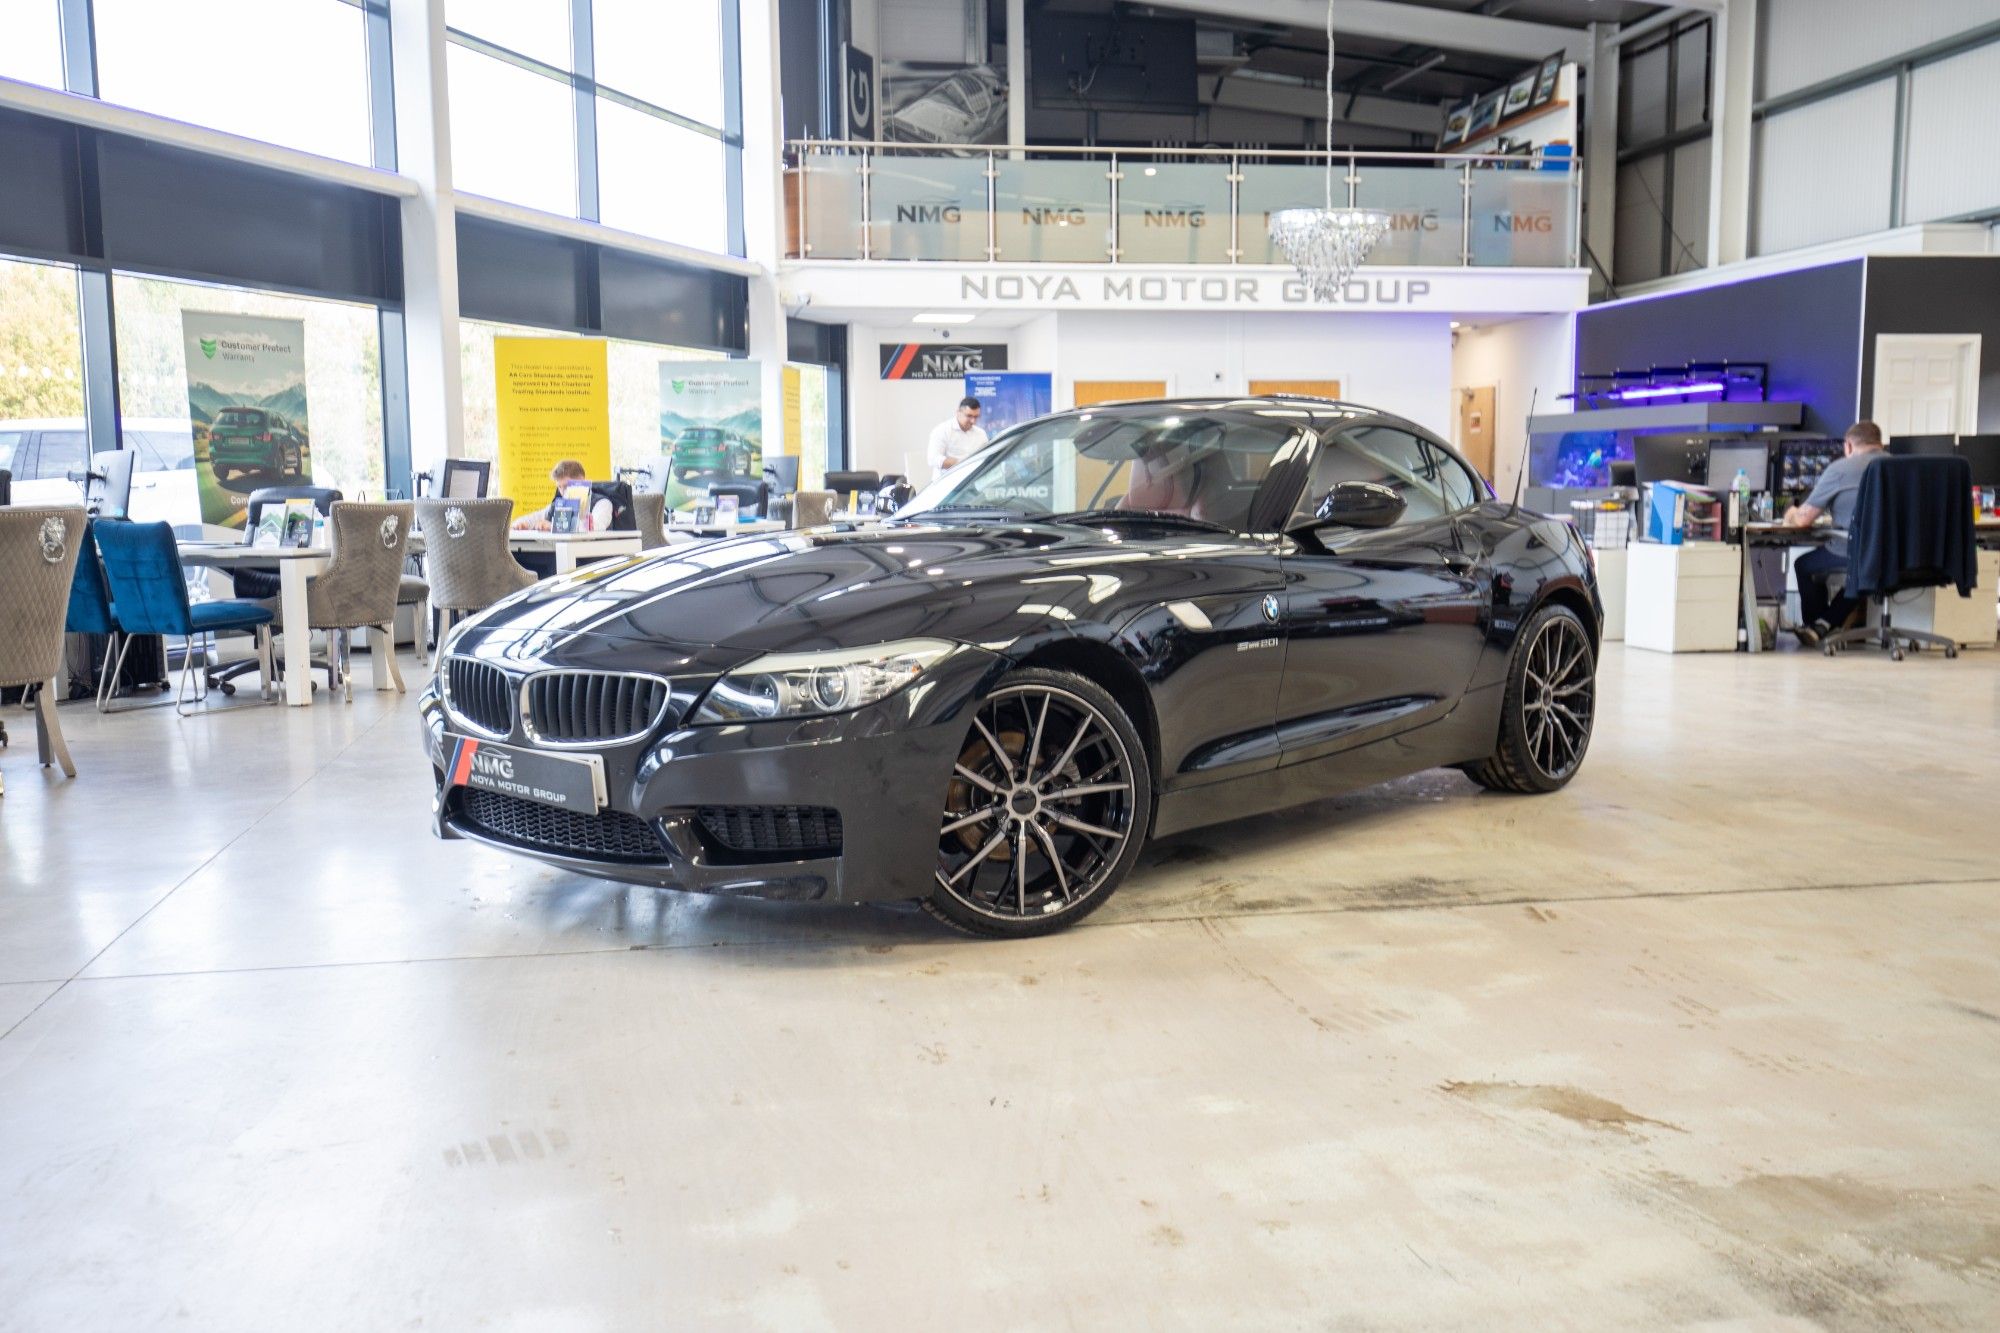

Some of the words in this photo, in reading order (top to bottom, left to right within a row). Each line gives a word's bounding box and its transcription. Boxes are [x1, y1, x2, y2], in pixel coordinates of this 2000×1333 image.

[897, 205, 962, 224] NMG
[1022, 207, 1086, 226] NMG
[1144, 209, 1206, 228] NMG
[1493, 213, 1553, 232] NMG
[961, 275, 1081, 301] NOYA
[1103, 277, 1259, 302] MOTOR
[221, 340, 260, 352] Customer
[262, 343, 291, 353] Protect
[222, 352, 255, 363] Warranty
[922, 354, 984, 372] NMG
[230, 495, 249, 506] Com
[469, 752, 514, 779] NMG
[471, 774, 495, 787] NOYA
[497, 780, 531, 796] MOTOR
[533, 787, 567, 803] GROUP
